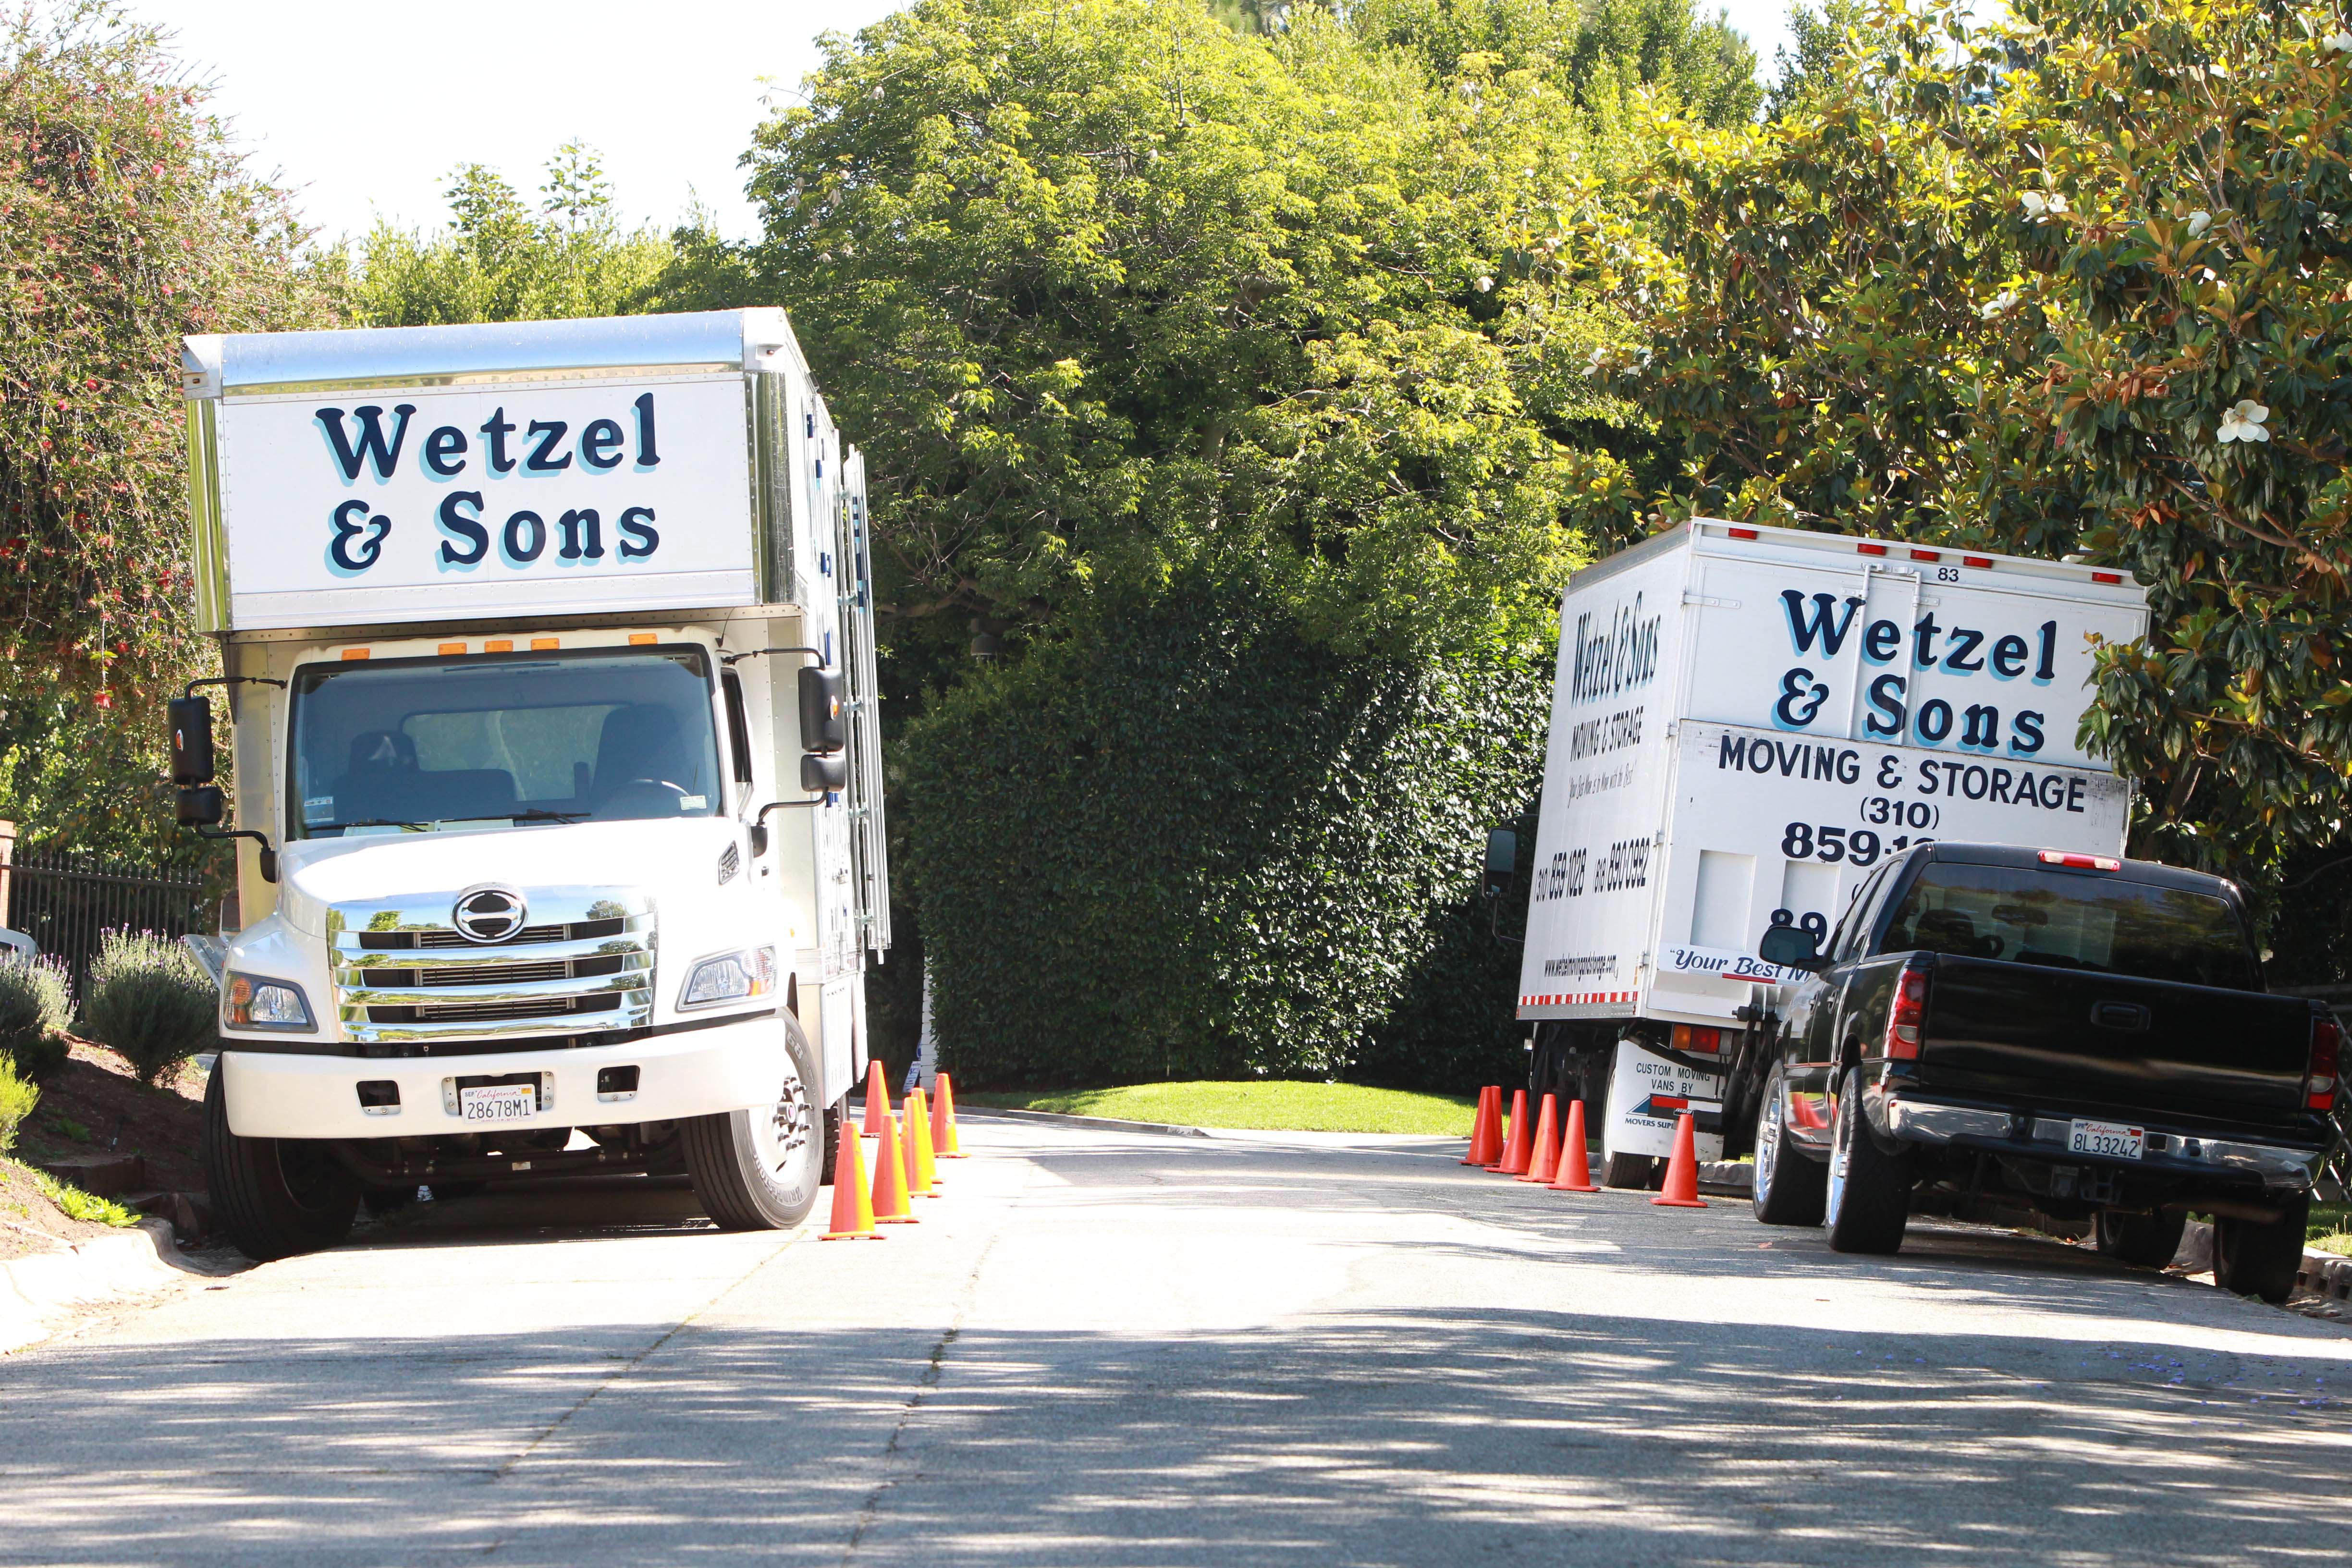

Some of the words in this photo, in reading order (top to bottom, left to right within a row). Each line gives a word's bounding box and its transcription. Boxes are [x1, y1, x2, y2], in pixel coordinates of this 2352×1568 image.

[312, 392, 661, 487] Wetzel
[325, 500, 392, 578] &
[434, 491, 660, 573] Sons
[1938, 567, 1959, 582] 83
[1571, 599, 1619, 709] Wetzel
[1614, 606, 1629, 699] &
[1625, 590, 1661, 692] Sons
[1778, 590, 2057, 686] Wetzel
[1771, 668, 1829, 732] &
[1862, 674, 2045, 757] Sons
[1570, 717, 1601, 762] MOVING
[1602, 715, 1608, 754] &
[1609, 705, 1644, 752] STORAGE
[1719, 735, 1860, 785] MOVING
[1877, 755, 1902, 789] &
[1918, 760, 2087, 813] STORAGE
[1860, 796, 1940, 830] (310)
[1733, 957, 1784, 978] Best
[1636, 1063, 1671, 1077] CUSTOM
[1678, 1067, 1710, 1081] MOVING
[477, 1090, 522, 1100] California
[1652, 1078, 1674, 1091] VANS
[1681, 1083, 1693, 1093] BY
[468, 1099, 531, 1119] 28678M1
[1625, 1117, 1655, 1127] MOVERS
[2086, 1124, 2131, 1137] California
[2073, 1133, 2138, 1158] 8L33242
